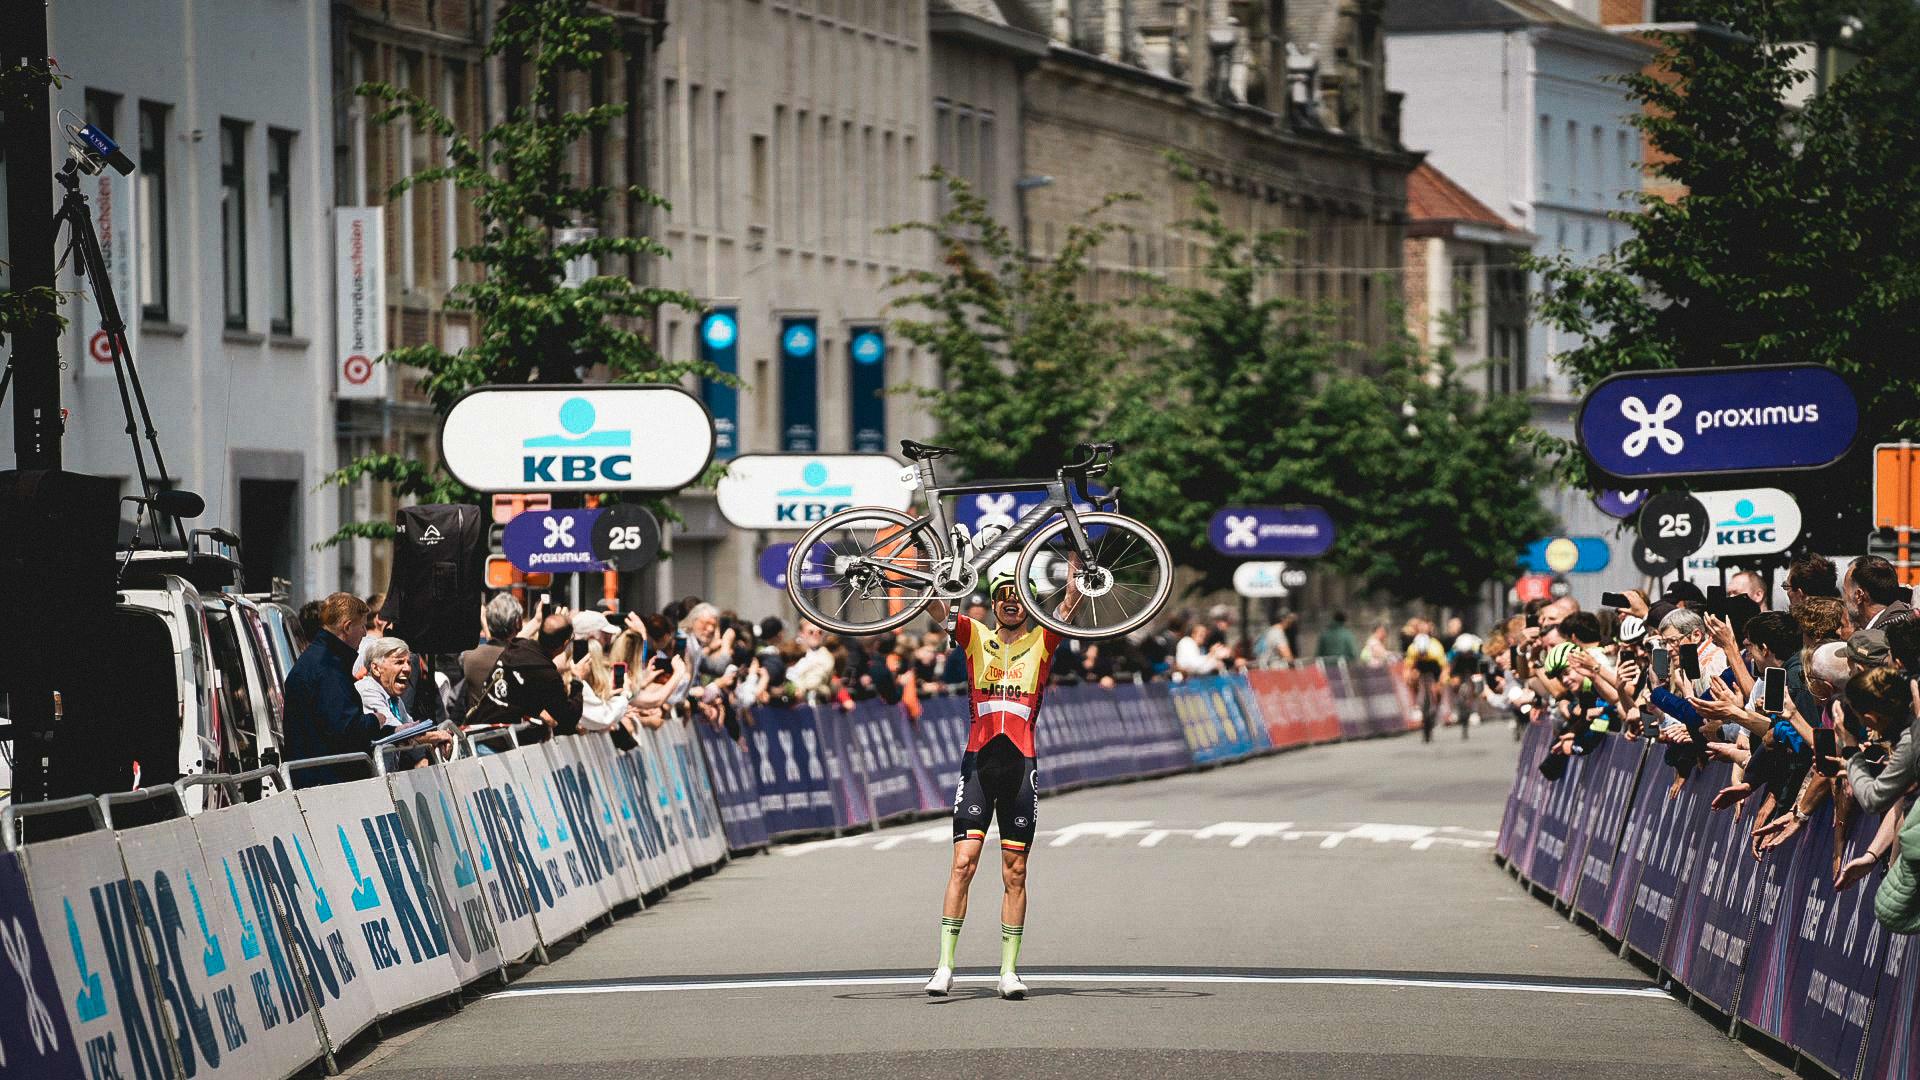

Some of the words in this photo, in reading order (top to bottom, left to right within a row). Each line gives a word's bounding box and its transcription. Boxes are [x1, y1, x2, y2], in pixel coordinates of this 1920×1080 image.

[90, 134, 109, 151] LYNX
[1696, 403, 1819, 435] proximus
[523, 455, 632, 482] KBC
[608, 526, 642, 550] 25
[1658, 513, 1691, 538] 25
[1716, 527, 1777, 545] KBC
[472, 782, 555, 922] KBC
[552, 761, 614, 886] KBC
[361, 791, 472, 964] KBC
[238, 835, 342, 1025] KBC
[361, 916, 402, 971] KBC
[463, 895, 496, 954] KBC
[90, 869, 221, 1080] KBC
[326, 928, 358, 985] KBC
[213, 984, 249, 1052] KBC
[250, 967, 282, 1032] KBC
